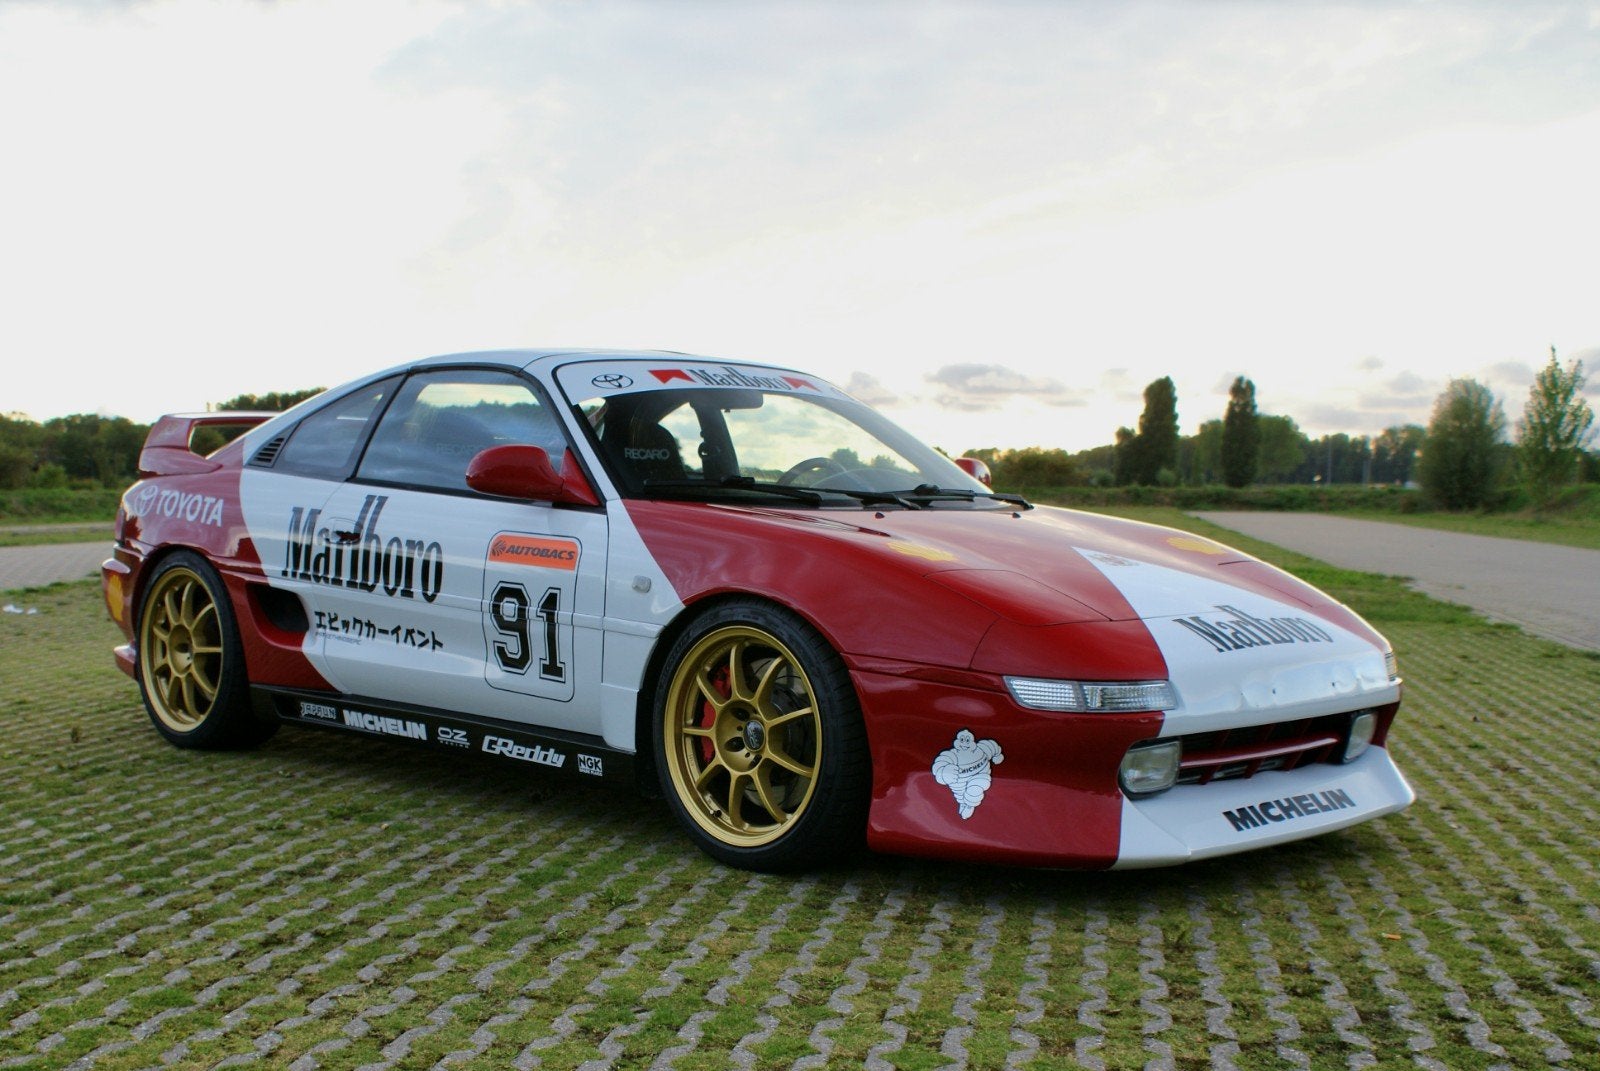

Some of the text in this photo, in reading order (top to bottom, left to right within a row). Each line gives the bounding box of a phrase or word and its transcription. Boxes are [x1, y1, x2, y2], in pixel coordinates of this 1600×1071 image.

[689, 366, 791, 391] Marlboro
[624, 447, 670, 460] RECARO
[156, 490, 224, 527] TOYOTA
[281, 495, 443, 603] Marlboro
[505, 544, 576, 561] AUTOBACS
[489, 581, 566, 684] 91
[1172, 604, 1334, 653] Marlboro
[343, 710, 427, 741] MICHELIN
[482, 735, 566, 768] GReddy
[578, 755, 602, 771] NGK
[1222, 788, 1356, 832] MICHELIN
